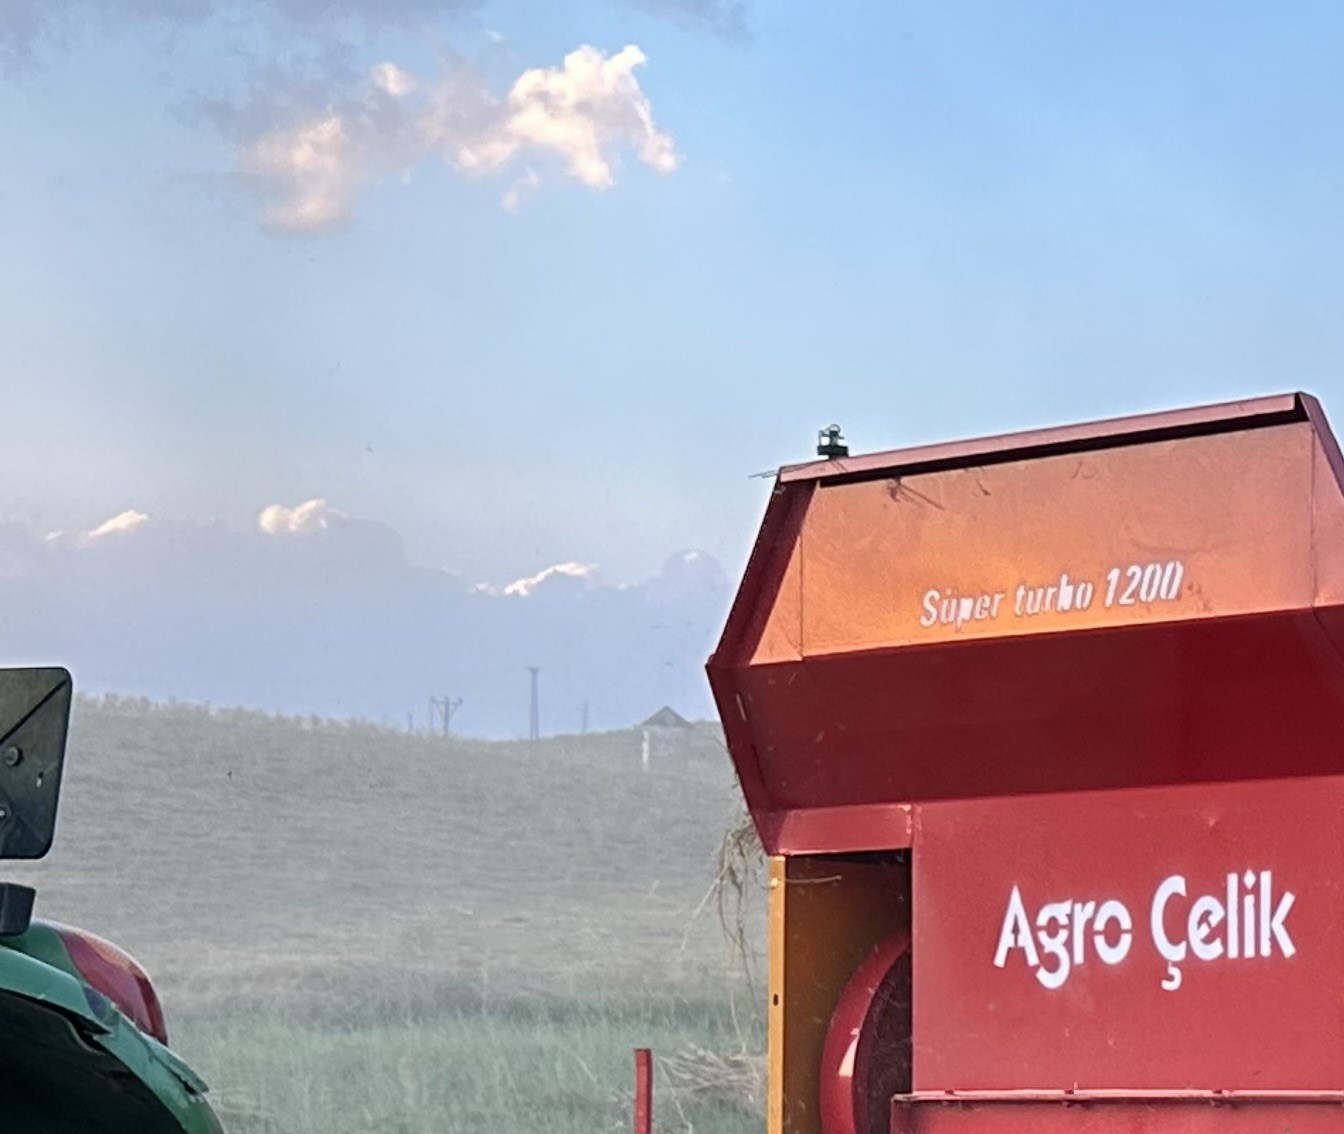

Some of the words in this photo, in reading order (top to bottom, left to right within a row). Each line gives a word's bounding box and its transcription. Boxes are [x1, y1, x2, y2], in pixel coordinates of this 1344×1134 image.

[1014, 573, 1094, 616] turbo
[1104, 561, 1184, 608] 1200
[993, 884, 1132, 989] Agro
[1151, 869, 1296, 991] Çelik
